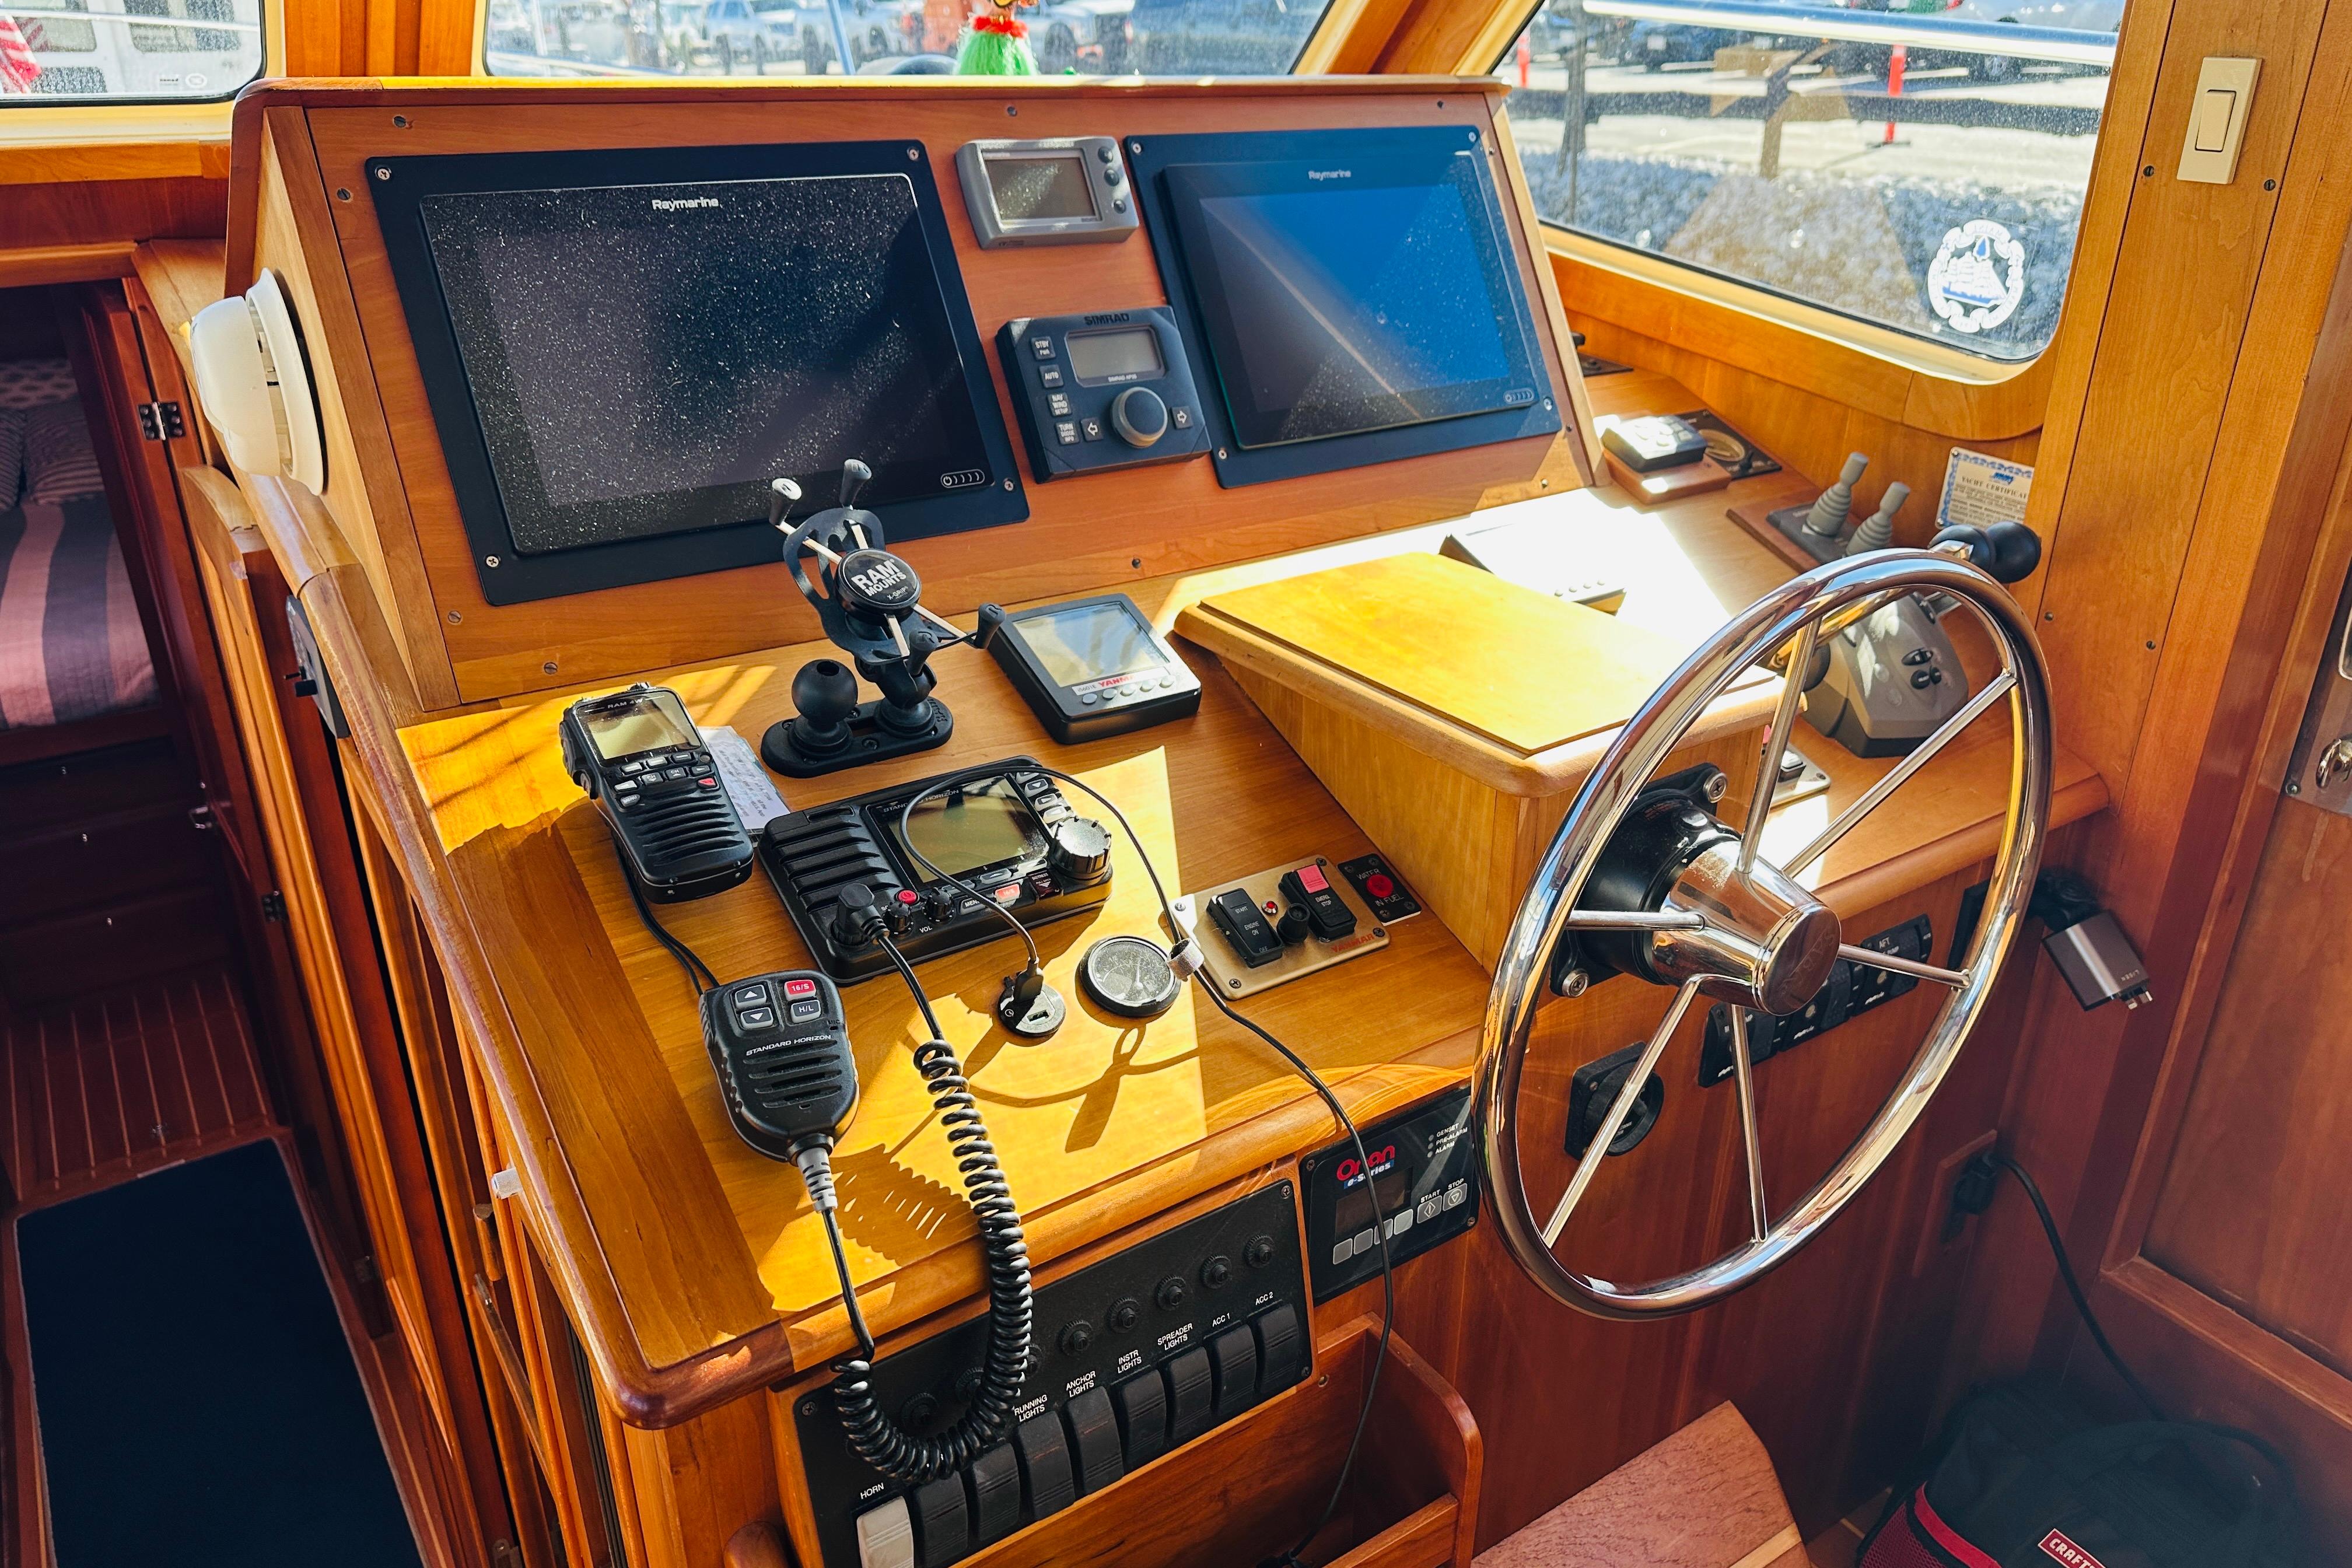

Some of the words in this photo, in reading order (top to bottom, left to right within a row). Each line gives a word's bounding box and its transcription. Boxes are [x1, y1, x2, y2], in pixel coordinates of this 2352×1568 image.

[1308, 169, 1352, 181] Raymarine
[652, 197, 719, 212] Raymarine
[1084, 313, 1130, 326] SIMRAD
[1035, 340, 1049, 349] STBY
[1045, 371, 1059, 380] AUTO
[1052, 400, 1068, 409] WIND
[1059, 422, 1074, 431] TURN
[1962, 475, 1984, 487] YACHT
[851, 559, 900, 590] RAM
[864, 572, 907, 597] MOUNTS
[1098, 674, 1136, 687] YANM
[622, 794, 638, 803] MENU
[926, 789, 959, 802] HORIZON
[1356, 868, 1382, 880] WATER
[965, 898, 980, 907] MEN
[1385, 892, 1405, 904] FUEL
[1234, 905, 1248, 914] START
[1244, 921, 1260, 930] ENGINE
[1330, 933, 1376, 953] YANMAR
[1878, 936, 1891, 949] AFT
[791, 983, 810, 992] 16/S
[799, 1005, 814, 1013] H/L
[746, 1040, 792, 1056] STANDARD
[794, 1034, 832, 1045] HORIZON
[1436, 1122, 1460, 1138] GENSET
[1436, 1126, 1468, 1146] PRE-ALARM
[1435, 1141, 1455, 1154] ALARM
[1346, 1161, 1391, 1187] e-Sries
[1420, 1189, 1441, 1203] START
[1447, 1178, 1465, 1191] STOP
[1255, 1293, 1269, 1306] ACC
[1268, 1291, 1273, 1299] 2
[1212, 1315, 1226, 1327] ACC
[1157, 1323, 1194, 1346] SPREADER
[1164, 1334, 1188, 1351] LIGHTS
[1118, 1349, 1139, 1366] INSTR
[1117, 1356, 1142, 1374] LIGHTS
[1066, 1370, 1096, 1391] ANCHOR
[1069, 1380, 1095, 1398] LIGHTS
[1014, 1394, 1048, 1416] RUNNING
[1019, 1404, 1046, 1423] LIGHTS
[860, 1482, 884, 1500] HORN
[2049, 1538, 2096, 1568] CRAFT
